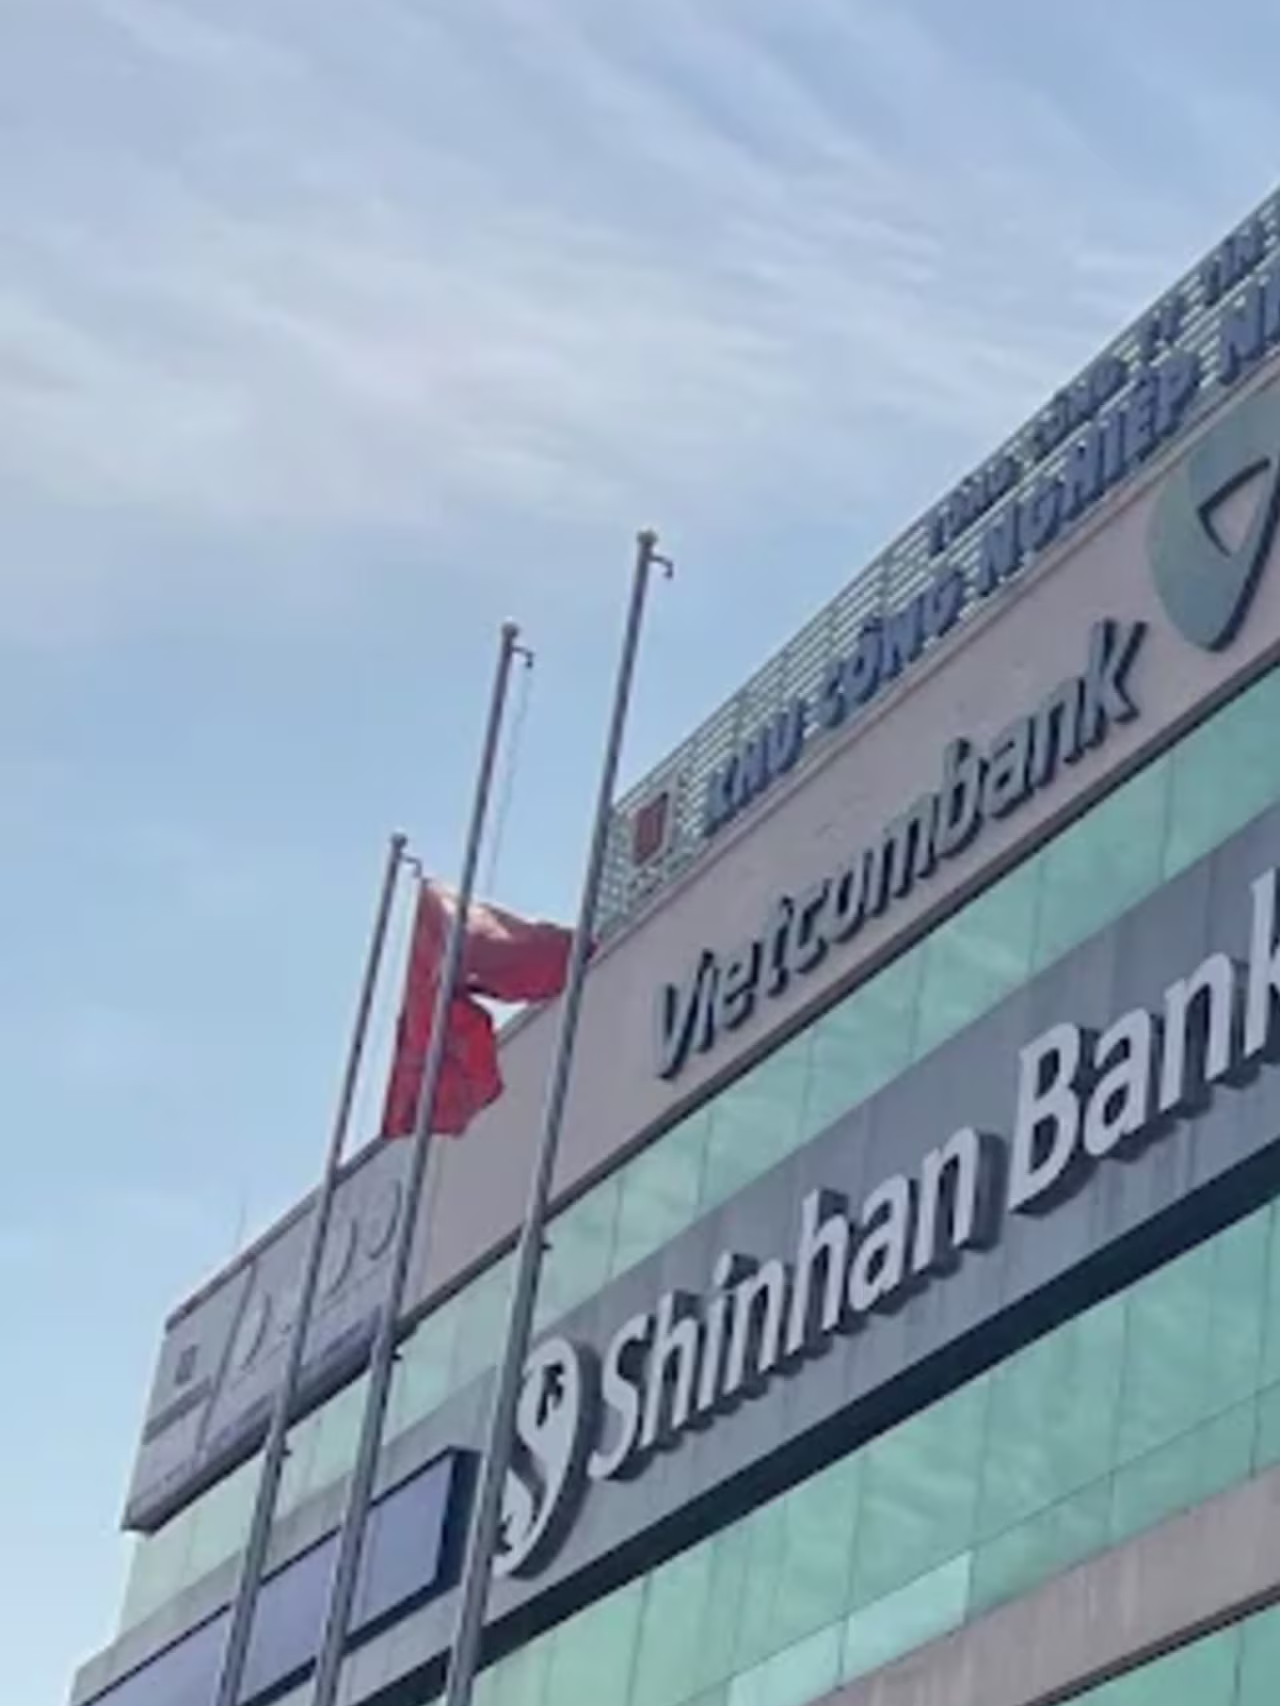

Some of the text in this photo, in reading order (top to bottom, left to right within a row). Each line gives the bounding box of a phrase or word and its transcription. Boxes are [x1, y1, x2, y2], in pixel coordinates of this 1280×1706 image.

[658, 618, 1148, 1080] Vietcombank
[700, 695, 804, 836] KHU
[818, 569, 968, 731] CÔNG
[588, 1125, 984, 1481] Shinhan
